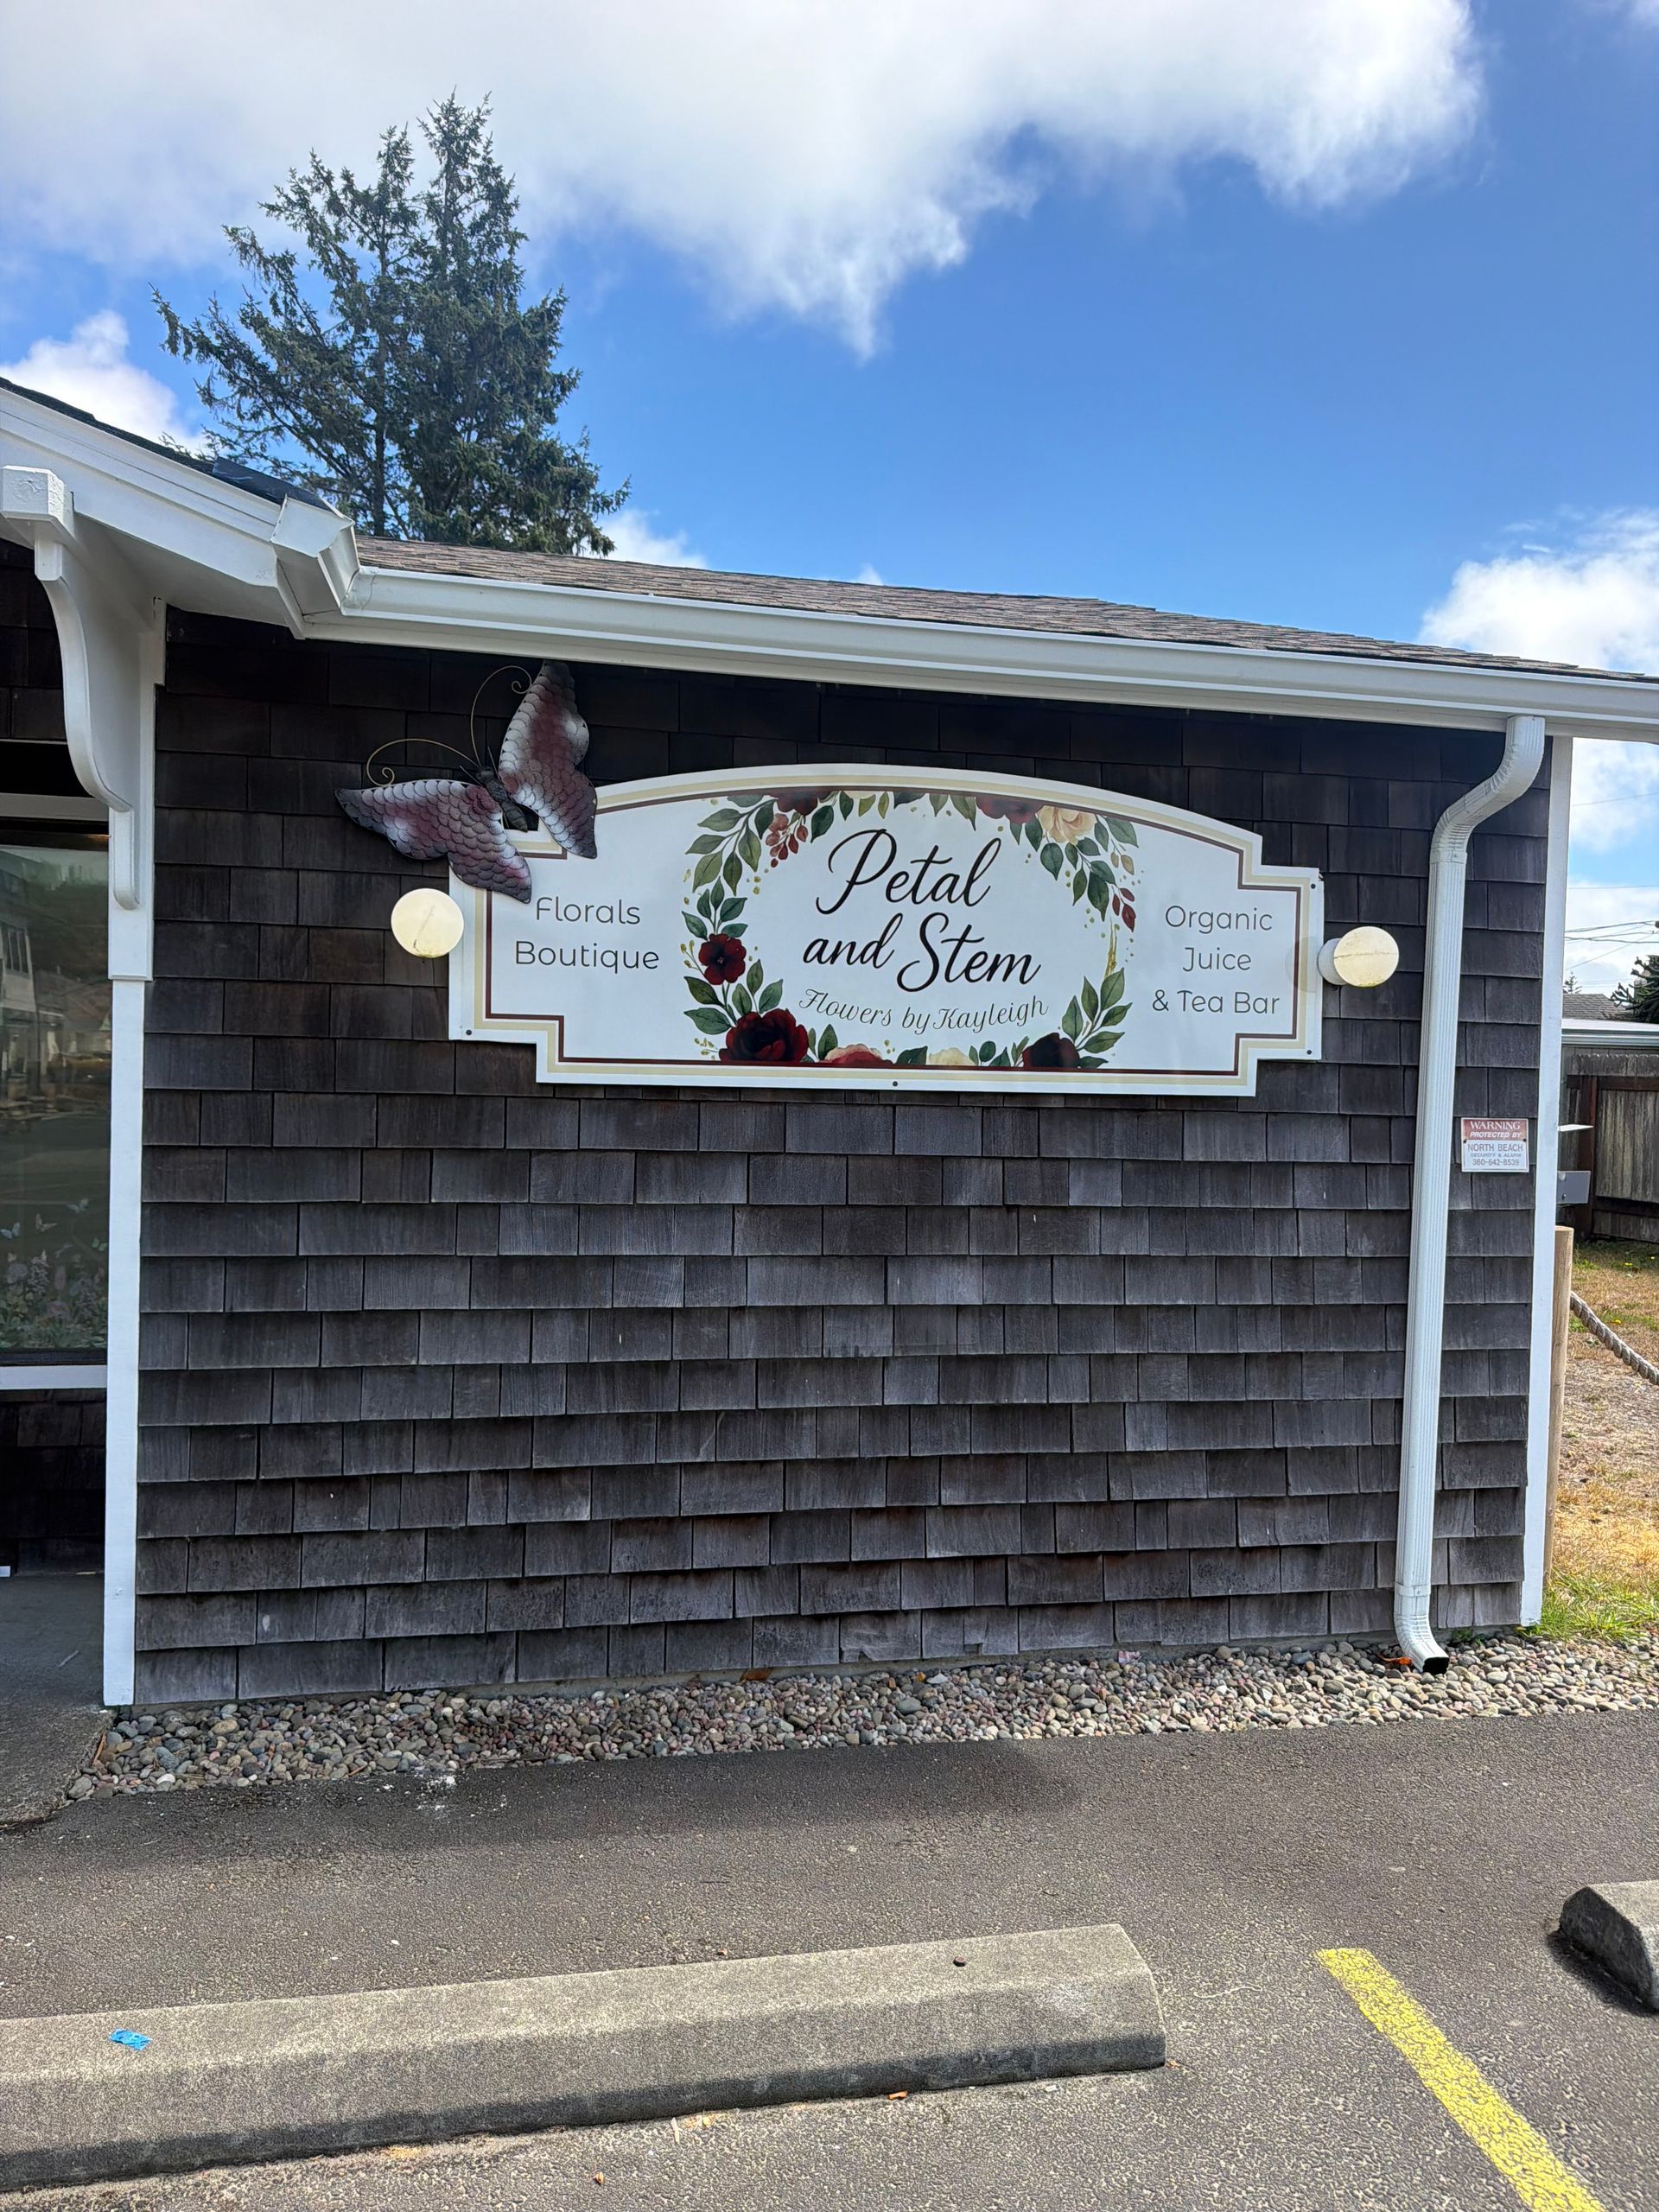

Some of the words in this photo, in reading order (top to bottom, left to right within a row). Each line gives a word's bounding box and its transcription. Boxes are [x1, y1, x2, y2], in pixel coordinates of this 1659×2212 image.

[816, 828, 1002, 915] Petal
[536, 896, 641, 925] Florals
[1165, 905, 1273, 934] Organic
[515, 940, 659, 974] Boutique
[803, 912, 904, 969] and
[896, 912, 1042, 992] Stem
[1182, 947, 1252, 972] Juice
[798, 988, 892, 1027] Flowers
[901, 1006, 931, 1035] by
[932, 995, 1048, 1033] Kayleigh
[1152, 989, 1169, 1013] &
[1176, 989, 1224, 1014] Tea
[1234, 990, 1281, 1014] Bar
[1470, 1121, 1521, 1130] WARNING
[1467, 1143, 1495, 1152] NORTH
[1497, 1143, 1523, 1152] BEACH
